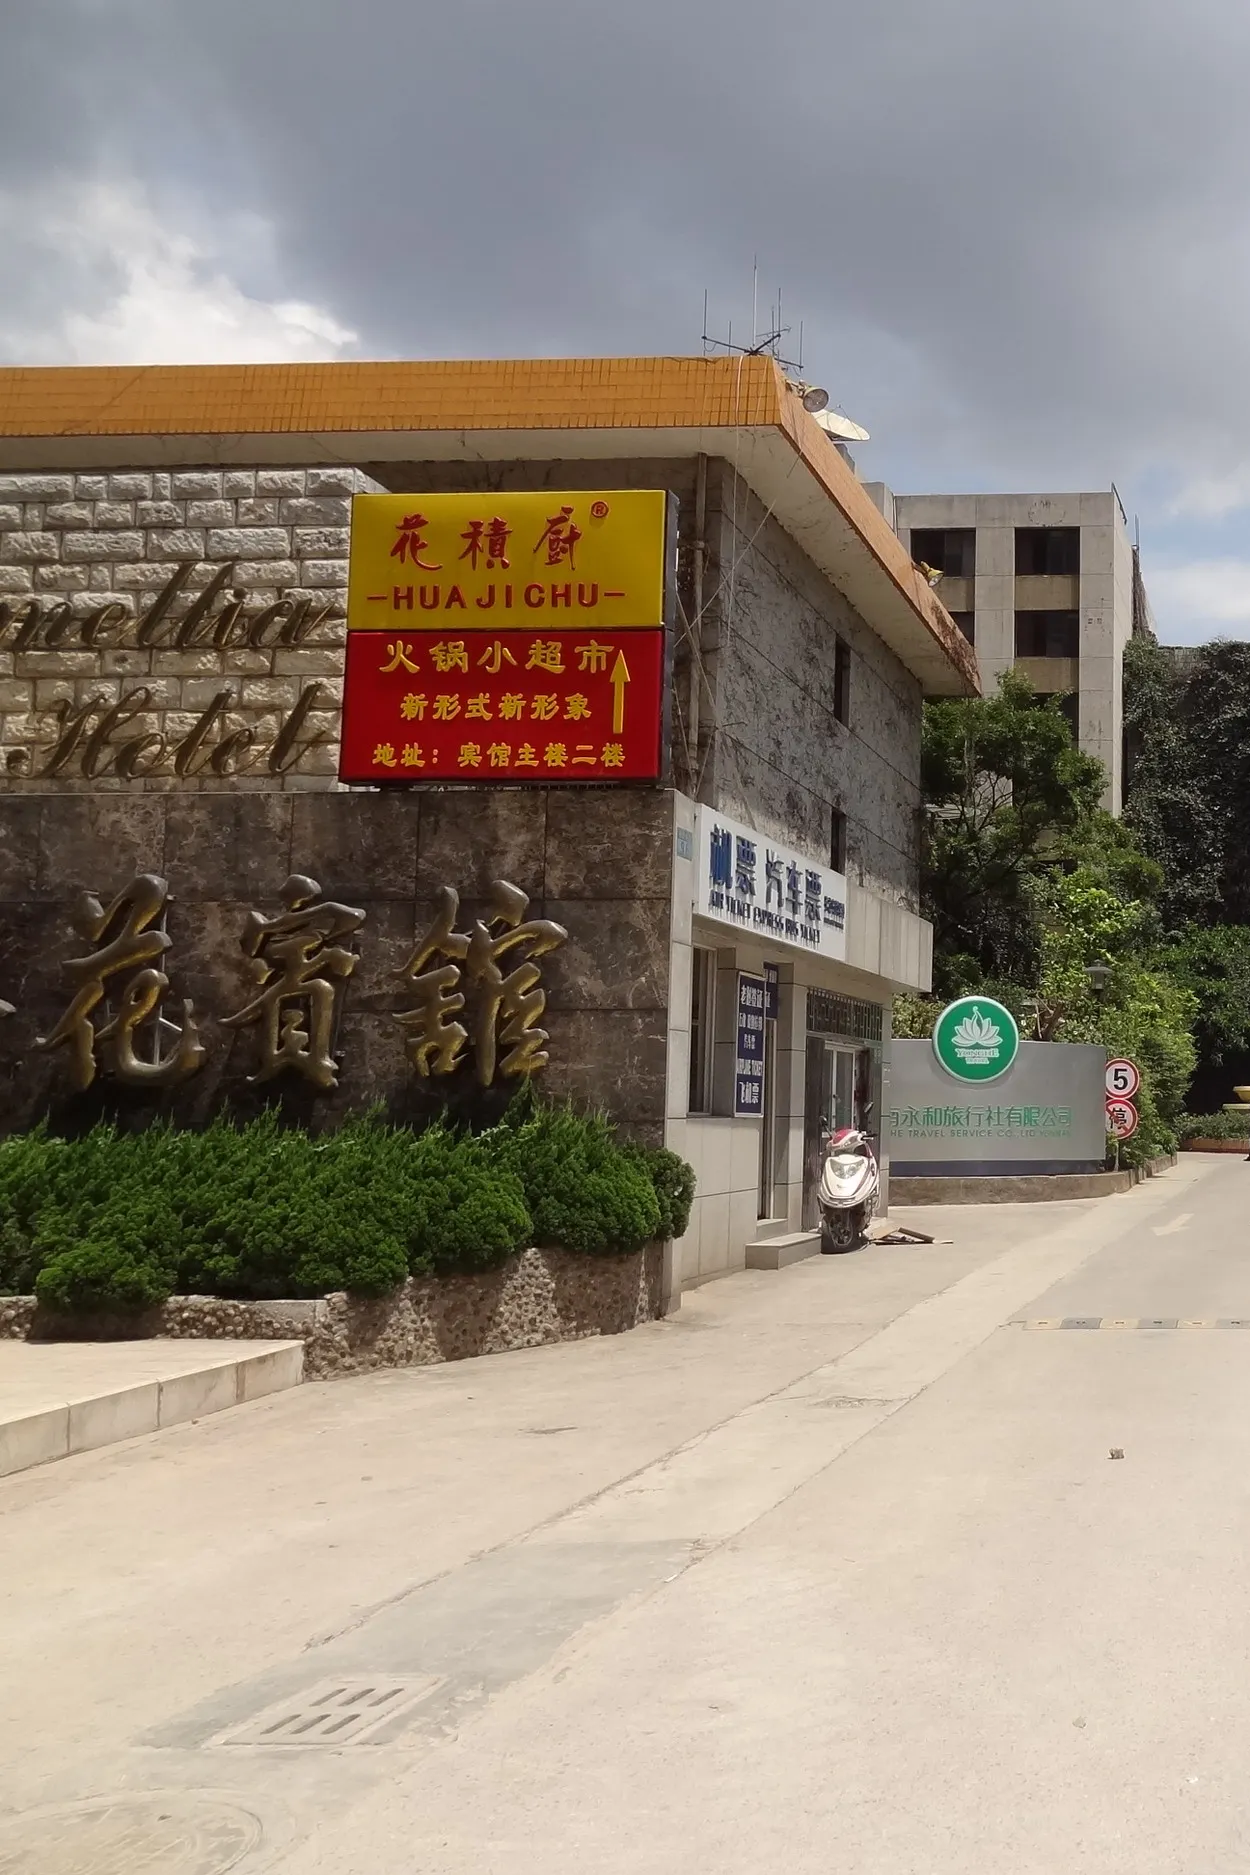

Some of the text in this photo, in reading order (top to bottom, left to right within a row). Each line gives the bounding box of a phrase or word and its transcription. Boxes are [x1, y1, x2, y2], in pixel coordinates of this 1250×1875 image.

[379, 639, 615, 673] 火锅小超市
[400, 692, 592, 721] 新形式新形象
[765, 848, 822, 922] 汽车票
[1113, 1068, 1128, 1091] 5
[908, 1129, 945, 1138] TRAVEL
[950, 1129, 993, 1138] SERVICE
